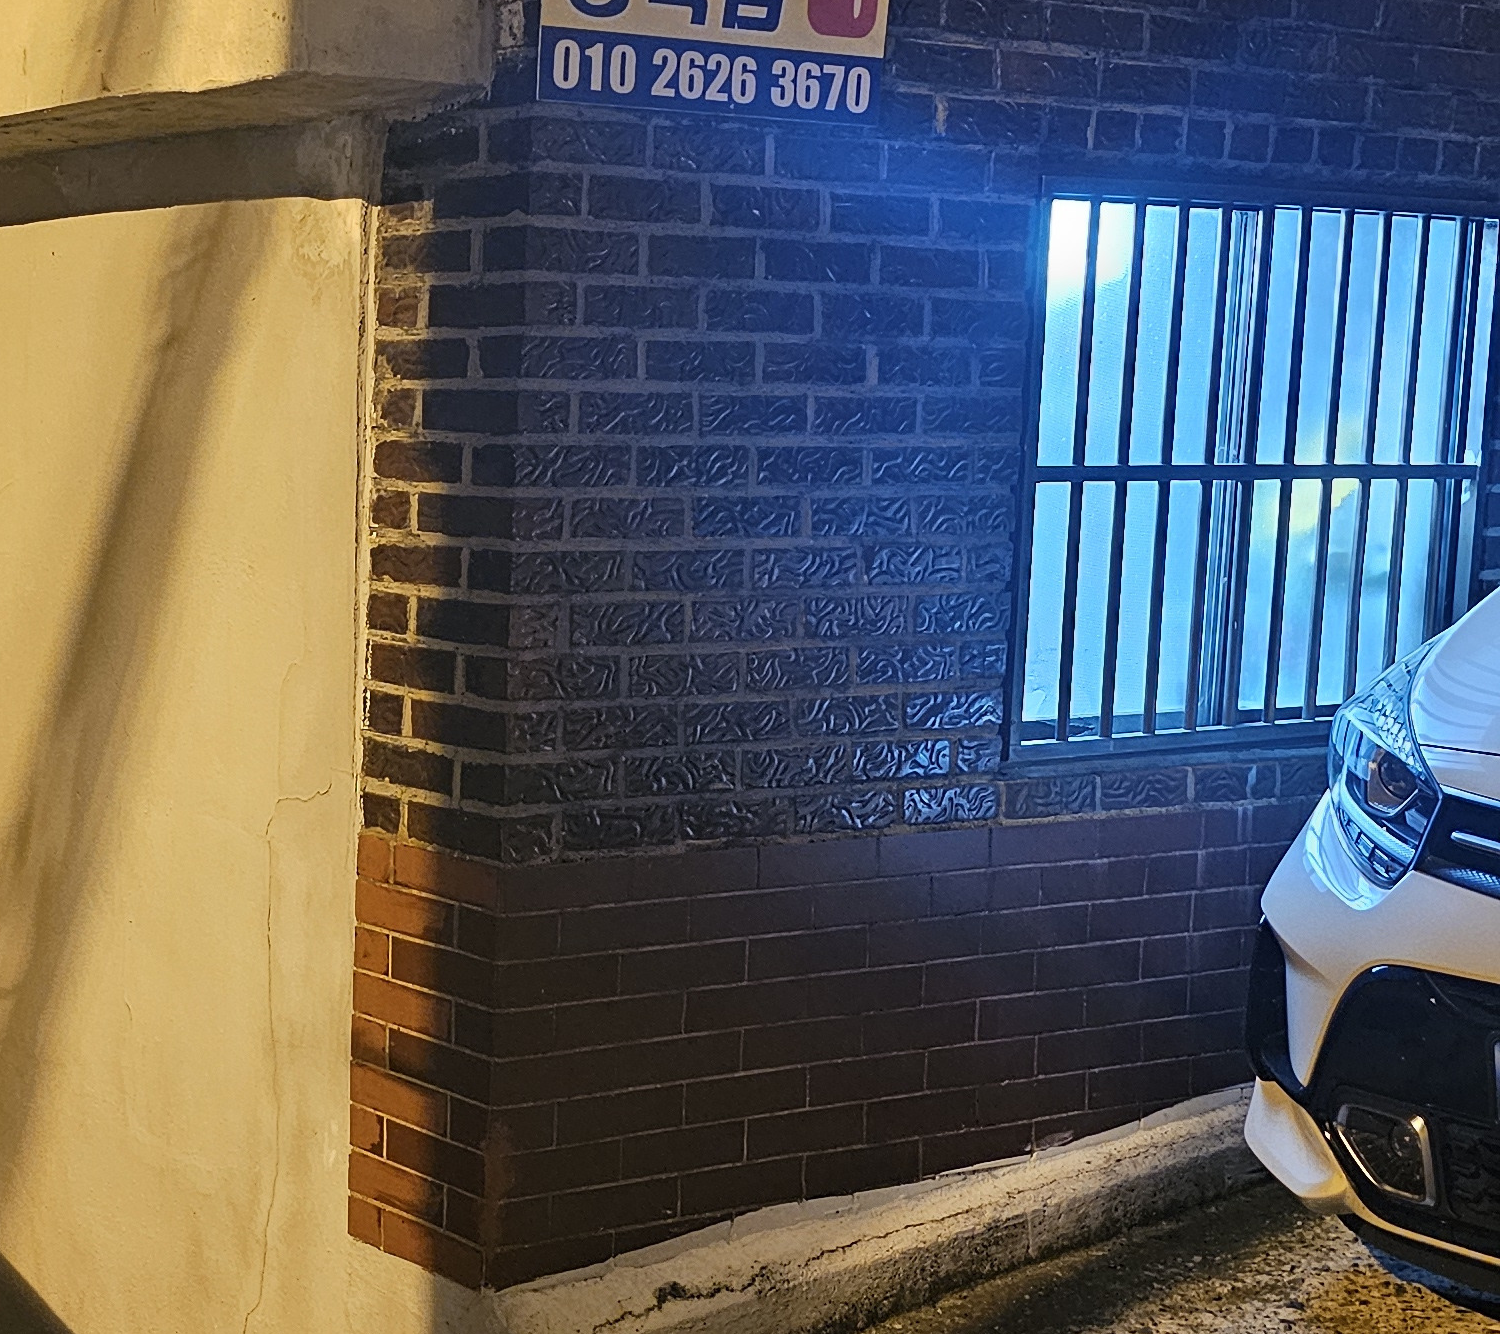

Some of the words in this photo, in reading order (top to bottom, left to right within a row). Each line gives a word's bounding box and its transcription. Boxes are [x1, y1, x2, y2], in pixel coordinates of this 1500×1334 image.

[553, 39, 637, 94] 010
[650, 48, 758, 104] 2626
[771, 59, 871, 114] 3670
